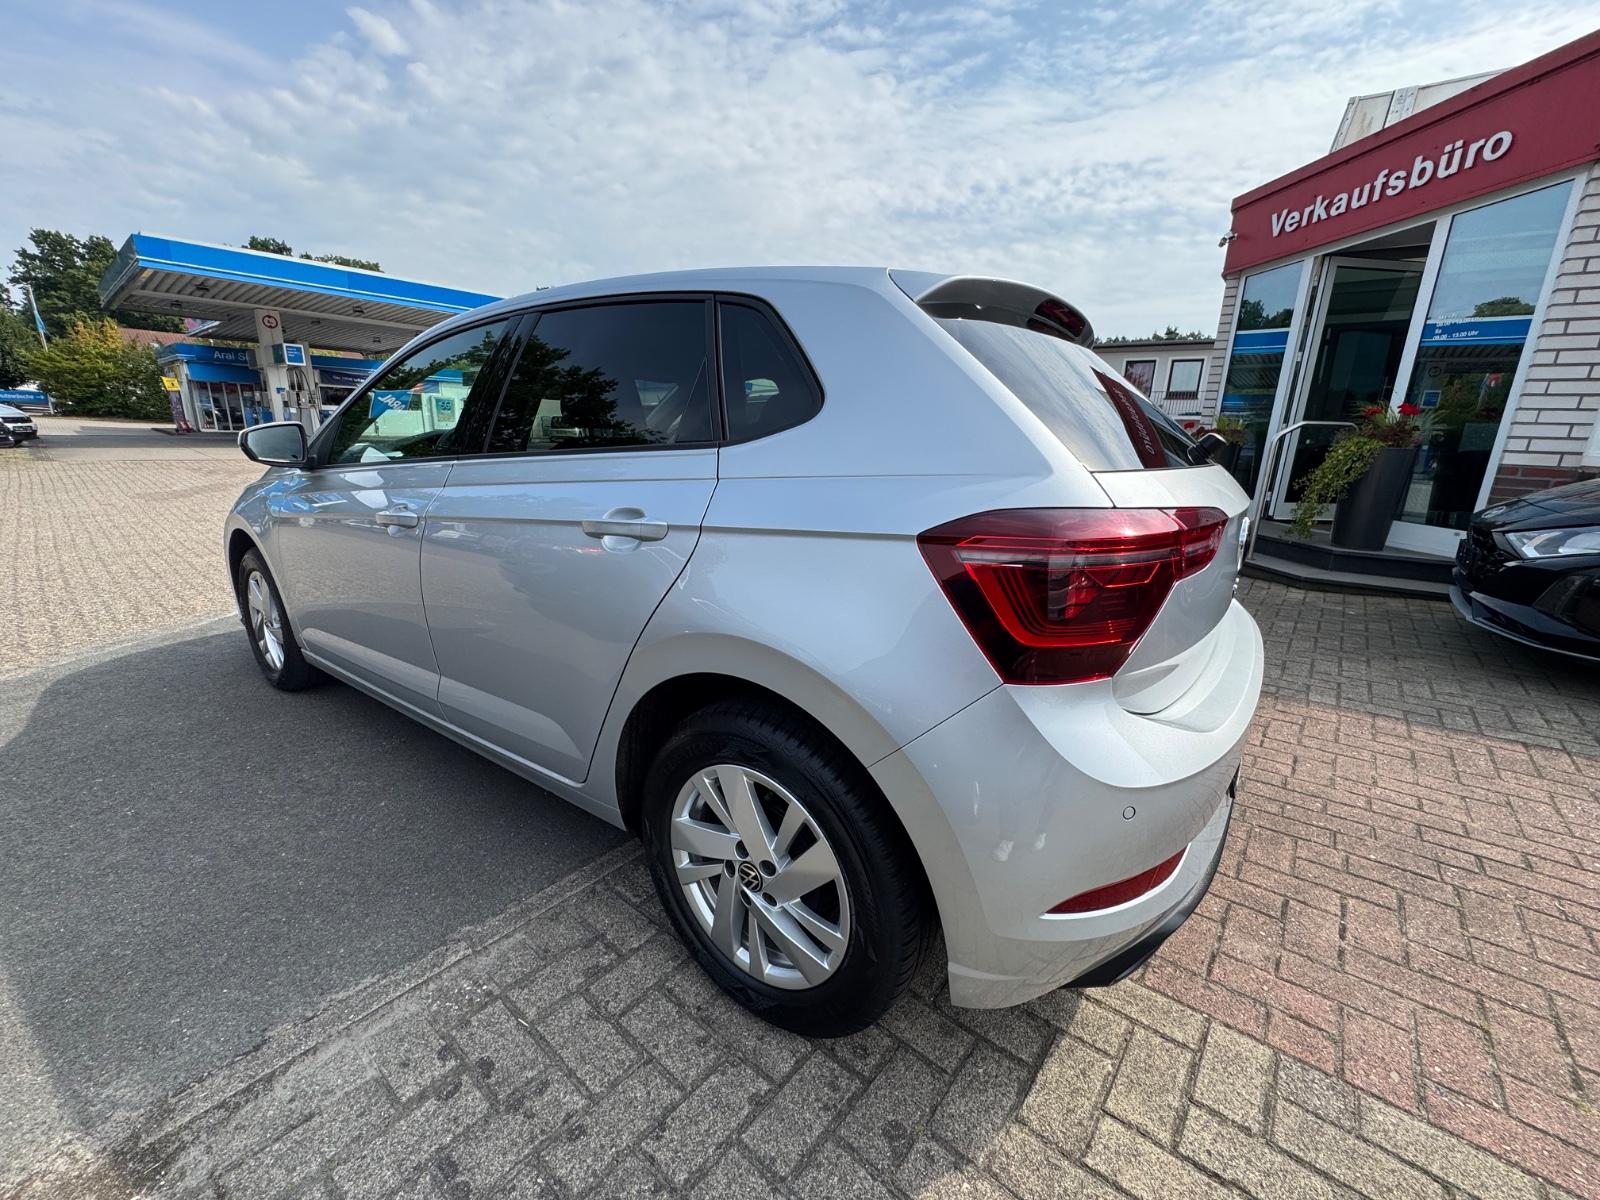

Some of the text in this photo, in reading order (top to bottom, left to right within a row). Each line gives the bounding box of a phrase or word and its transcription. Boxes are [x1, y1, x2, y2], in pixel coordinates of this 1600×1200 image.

[1271, 130, 1513, 237] Verkaufsbüro
[213, 350, 248, 361] Aral S
